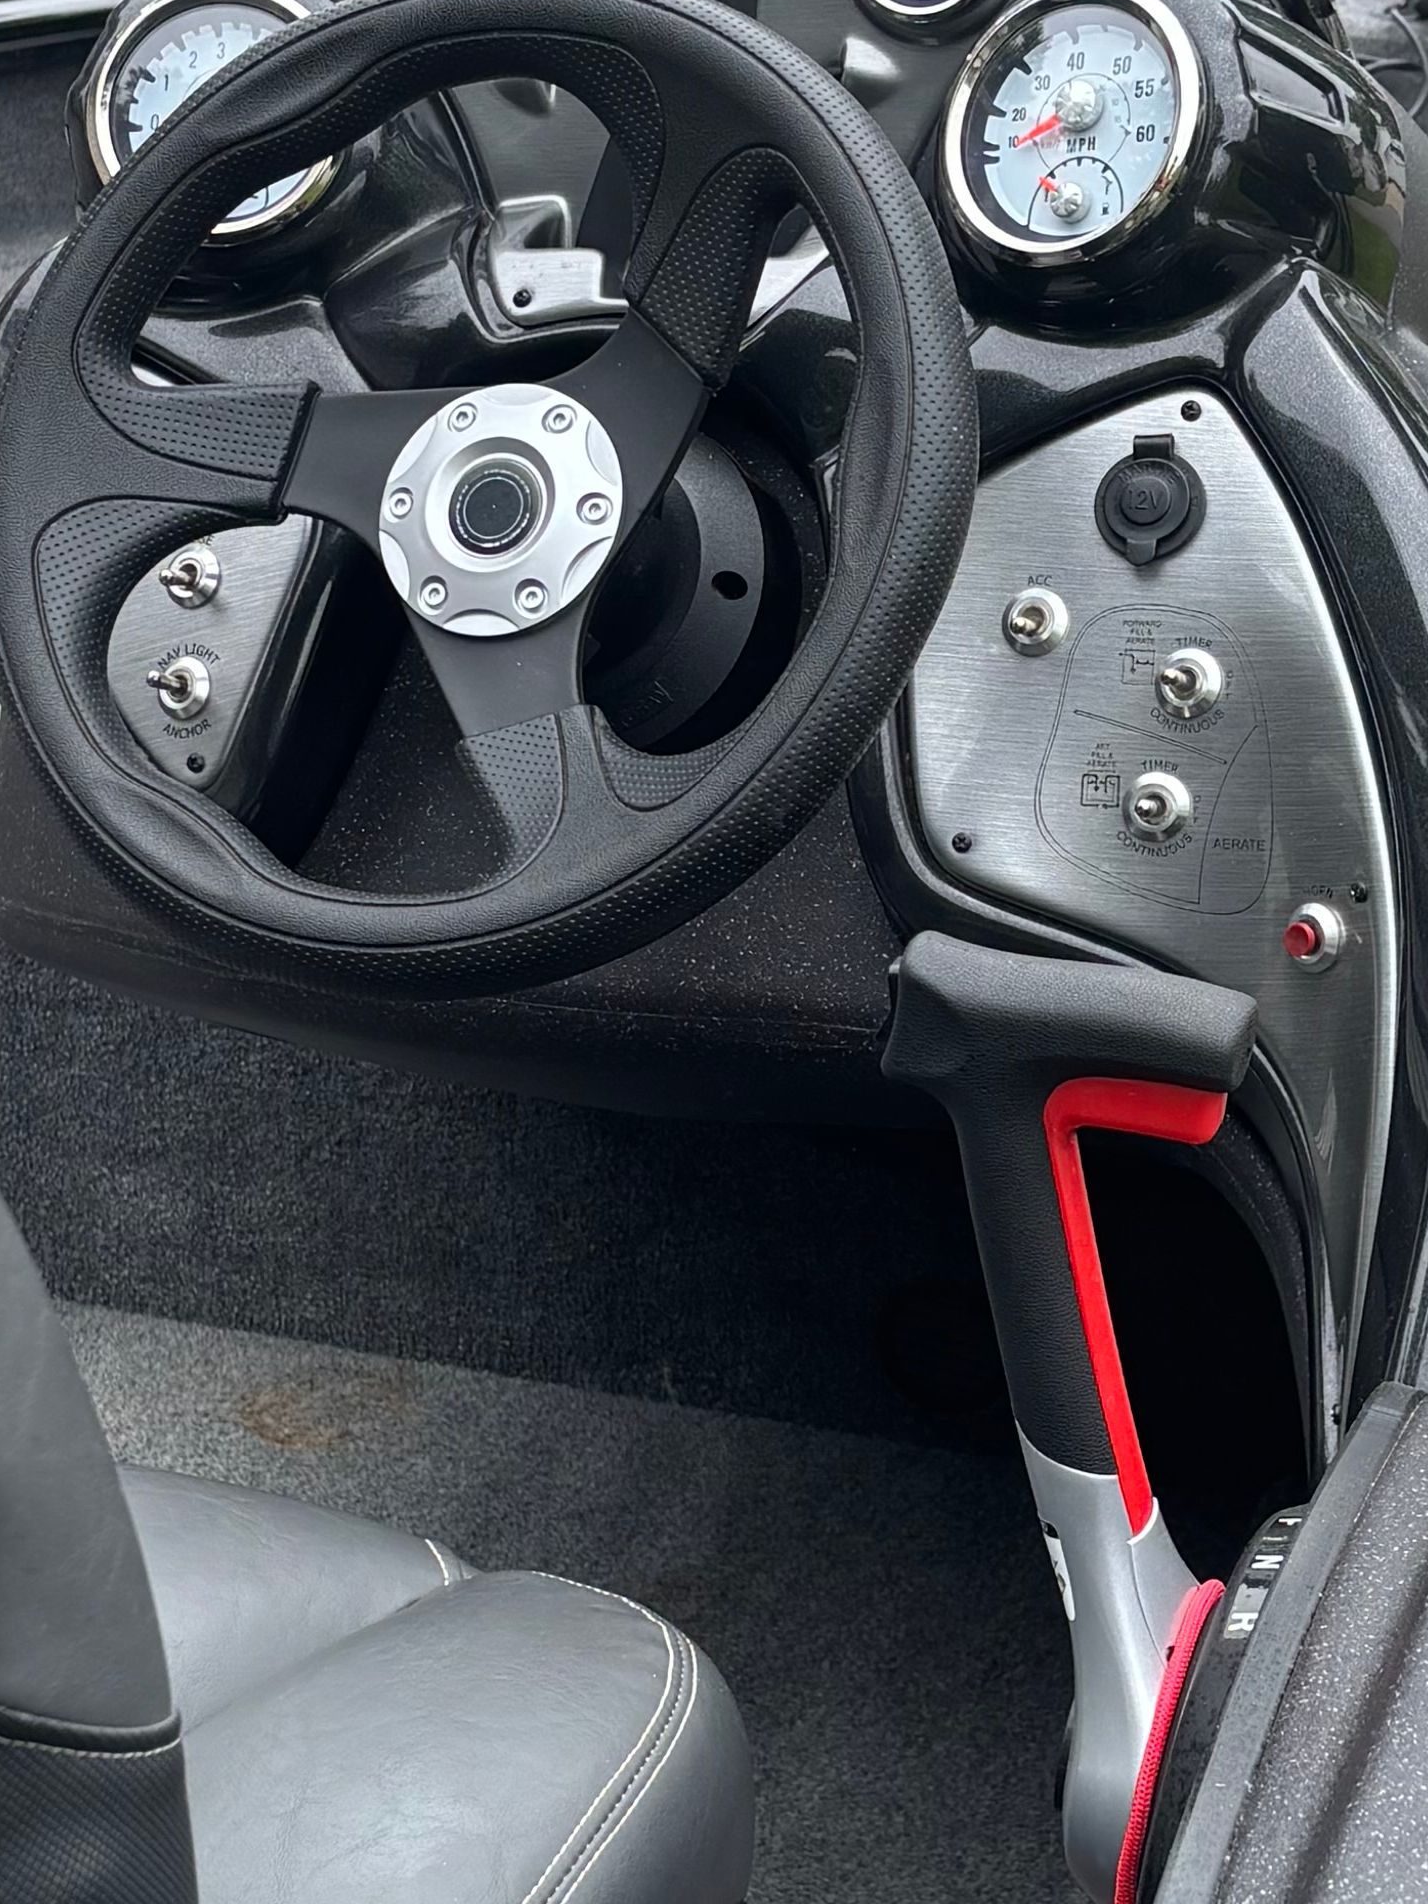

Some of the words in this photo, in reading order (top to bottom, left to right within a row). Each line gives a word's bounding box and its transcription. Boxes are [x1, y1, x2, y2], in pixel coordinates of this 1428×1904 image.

[188, 50, 198, 69] 2
[216, 41, 226, 60] 3
[1066, 51, 1085, 71] 40
[1112, 55, 1132, 75] 50
[1034, 75, 1051, 91] 30
[1134, 78, 1155, 99] 55
[150, 113, 160, 130] 0
[1011, 107, 1027, 122] 20
[1135, 124, 1156, 143] 60
[1066, 136, 1097, 154] MPH
[1027, 574, 1053, 587] ACC
[1175, 636, 1213, 648] TIMER
[157, 645, 181, 669] NAV
[184, 642, 222, 666] LIGHT
[161, 718, 213, 740] ANCHOR
[1150, 706, 1225, 734] CONTINUOUS
[1140, 759, 1180, 773] TIMER
[1115, 830, 1193, 858] CONTINUOUS
[1212, 837, 1267, 852] AERATE
[1250, 1554, 1285, 1570] N
[1227, 1612, 1259, 1632] R
